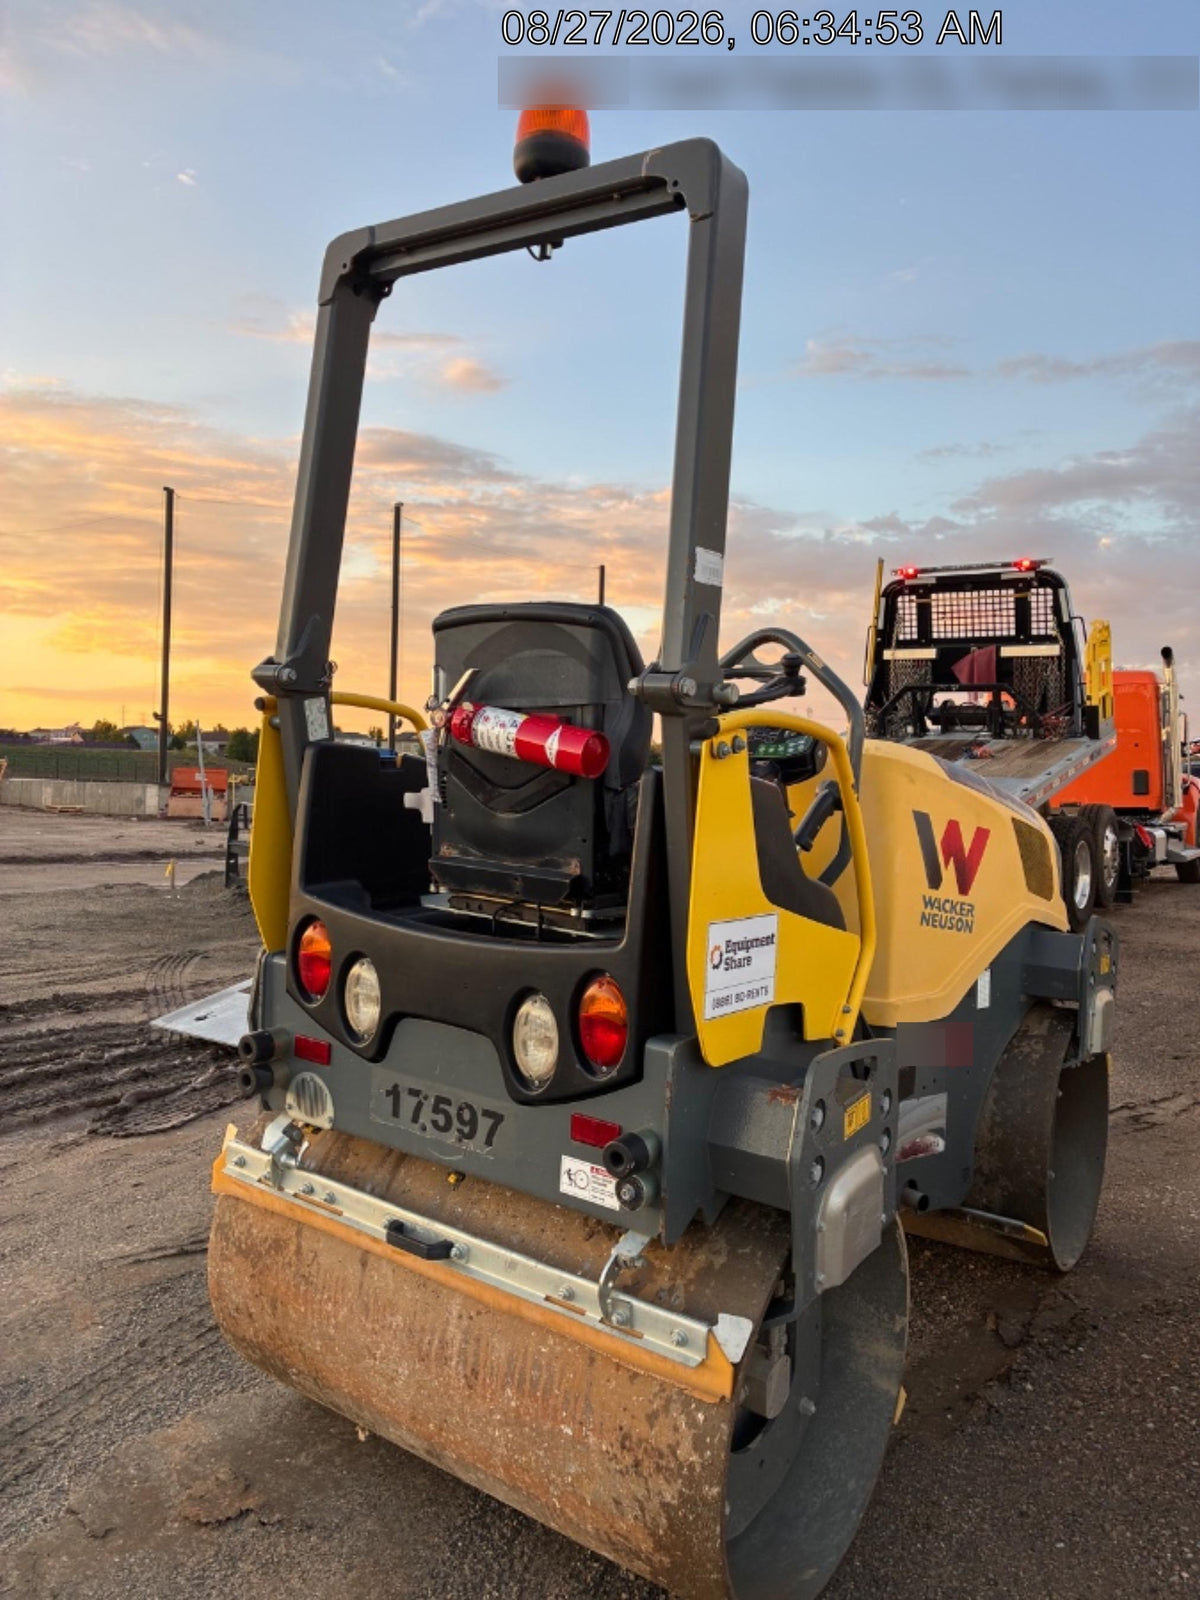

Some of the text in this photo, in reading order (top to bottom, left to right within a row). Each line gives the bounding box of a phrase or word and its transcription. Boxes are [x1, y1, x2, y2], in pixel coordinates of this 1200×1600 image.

[922, 894, 975, 917] WACKER
[920, 911, 974, 934] NEUSON
[725, 932, 775, 955] Equipment
[723, 955, 752, 971] Share
